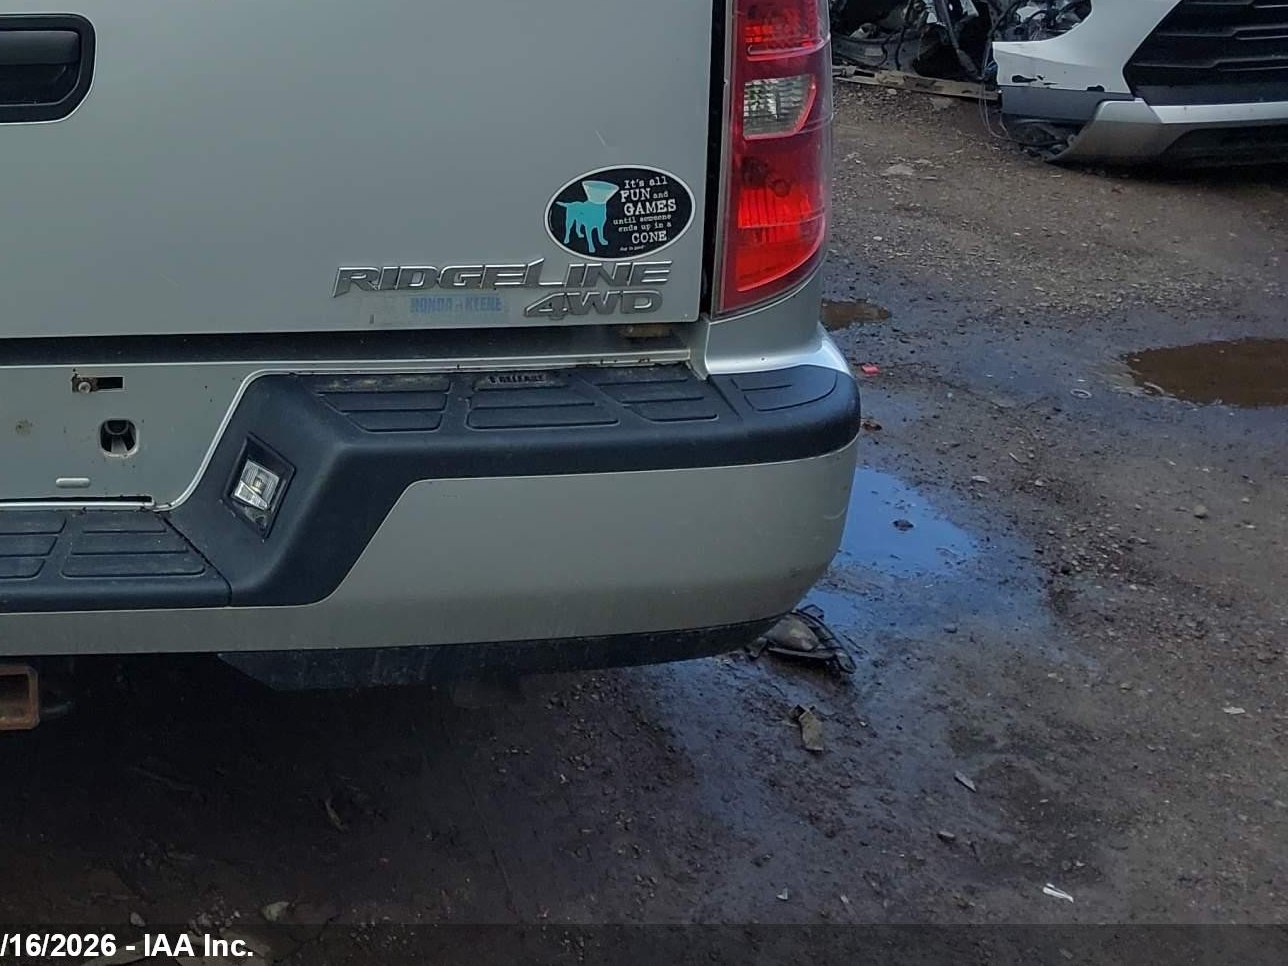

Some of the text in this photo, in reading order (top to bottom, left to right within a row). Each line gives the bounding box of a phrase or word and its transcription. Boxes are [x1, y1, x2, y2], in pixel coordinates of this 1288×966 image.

[624, 176, 668, 188] It's all
[620, 188, 669, 202] FUN and
[624, 199, 676, 215] GAMES
[613, 217, 636, 225] until
[618, 224, 638, 232] ends
[632, 230, 667, 244] CONE
[332, 257, 673, 297] RIDGELINE
[524, 289, 663, 320] 4WD
